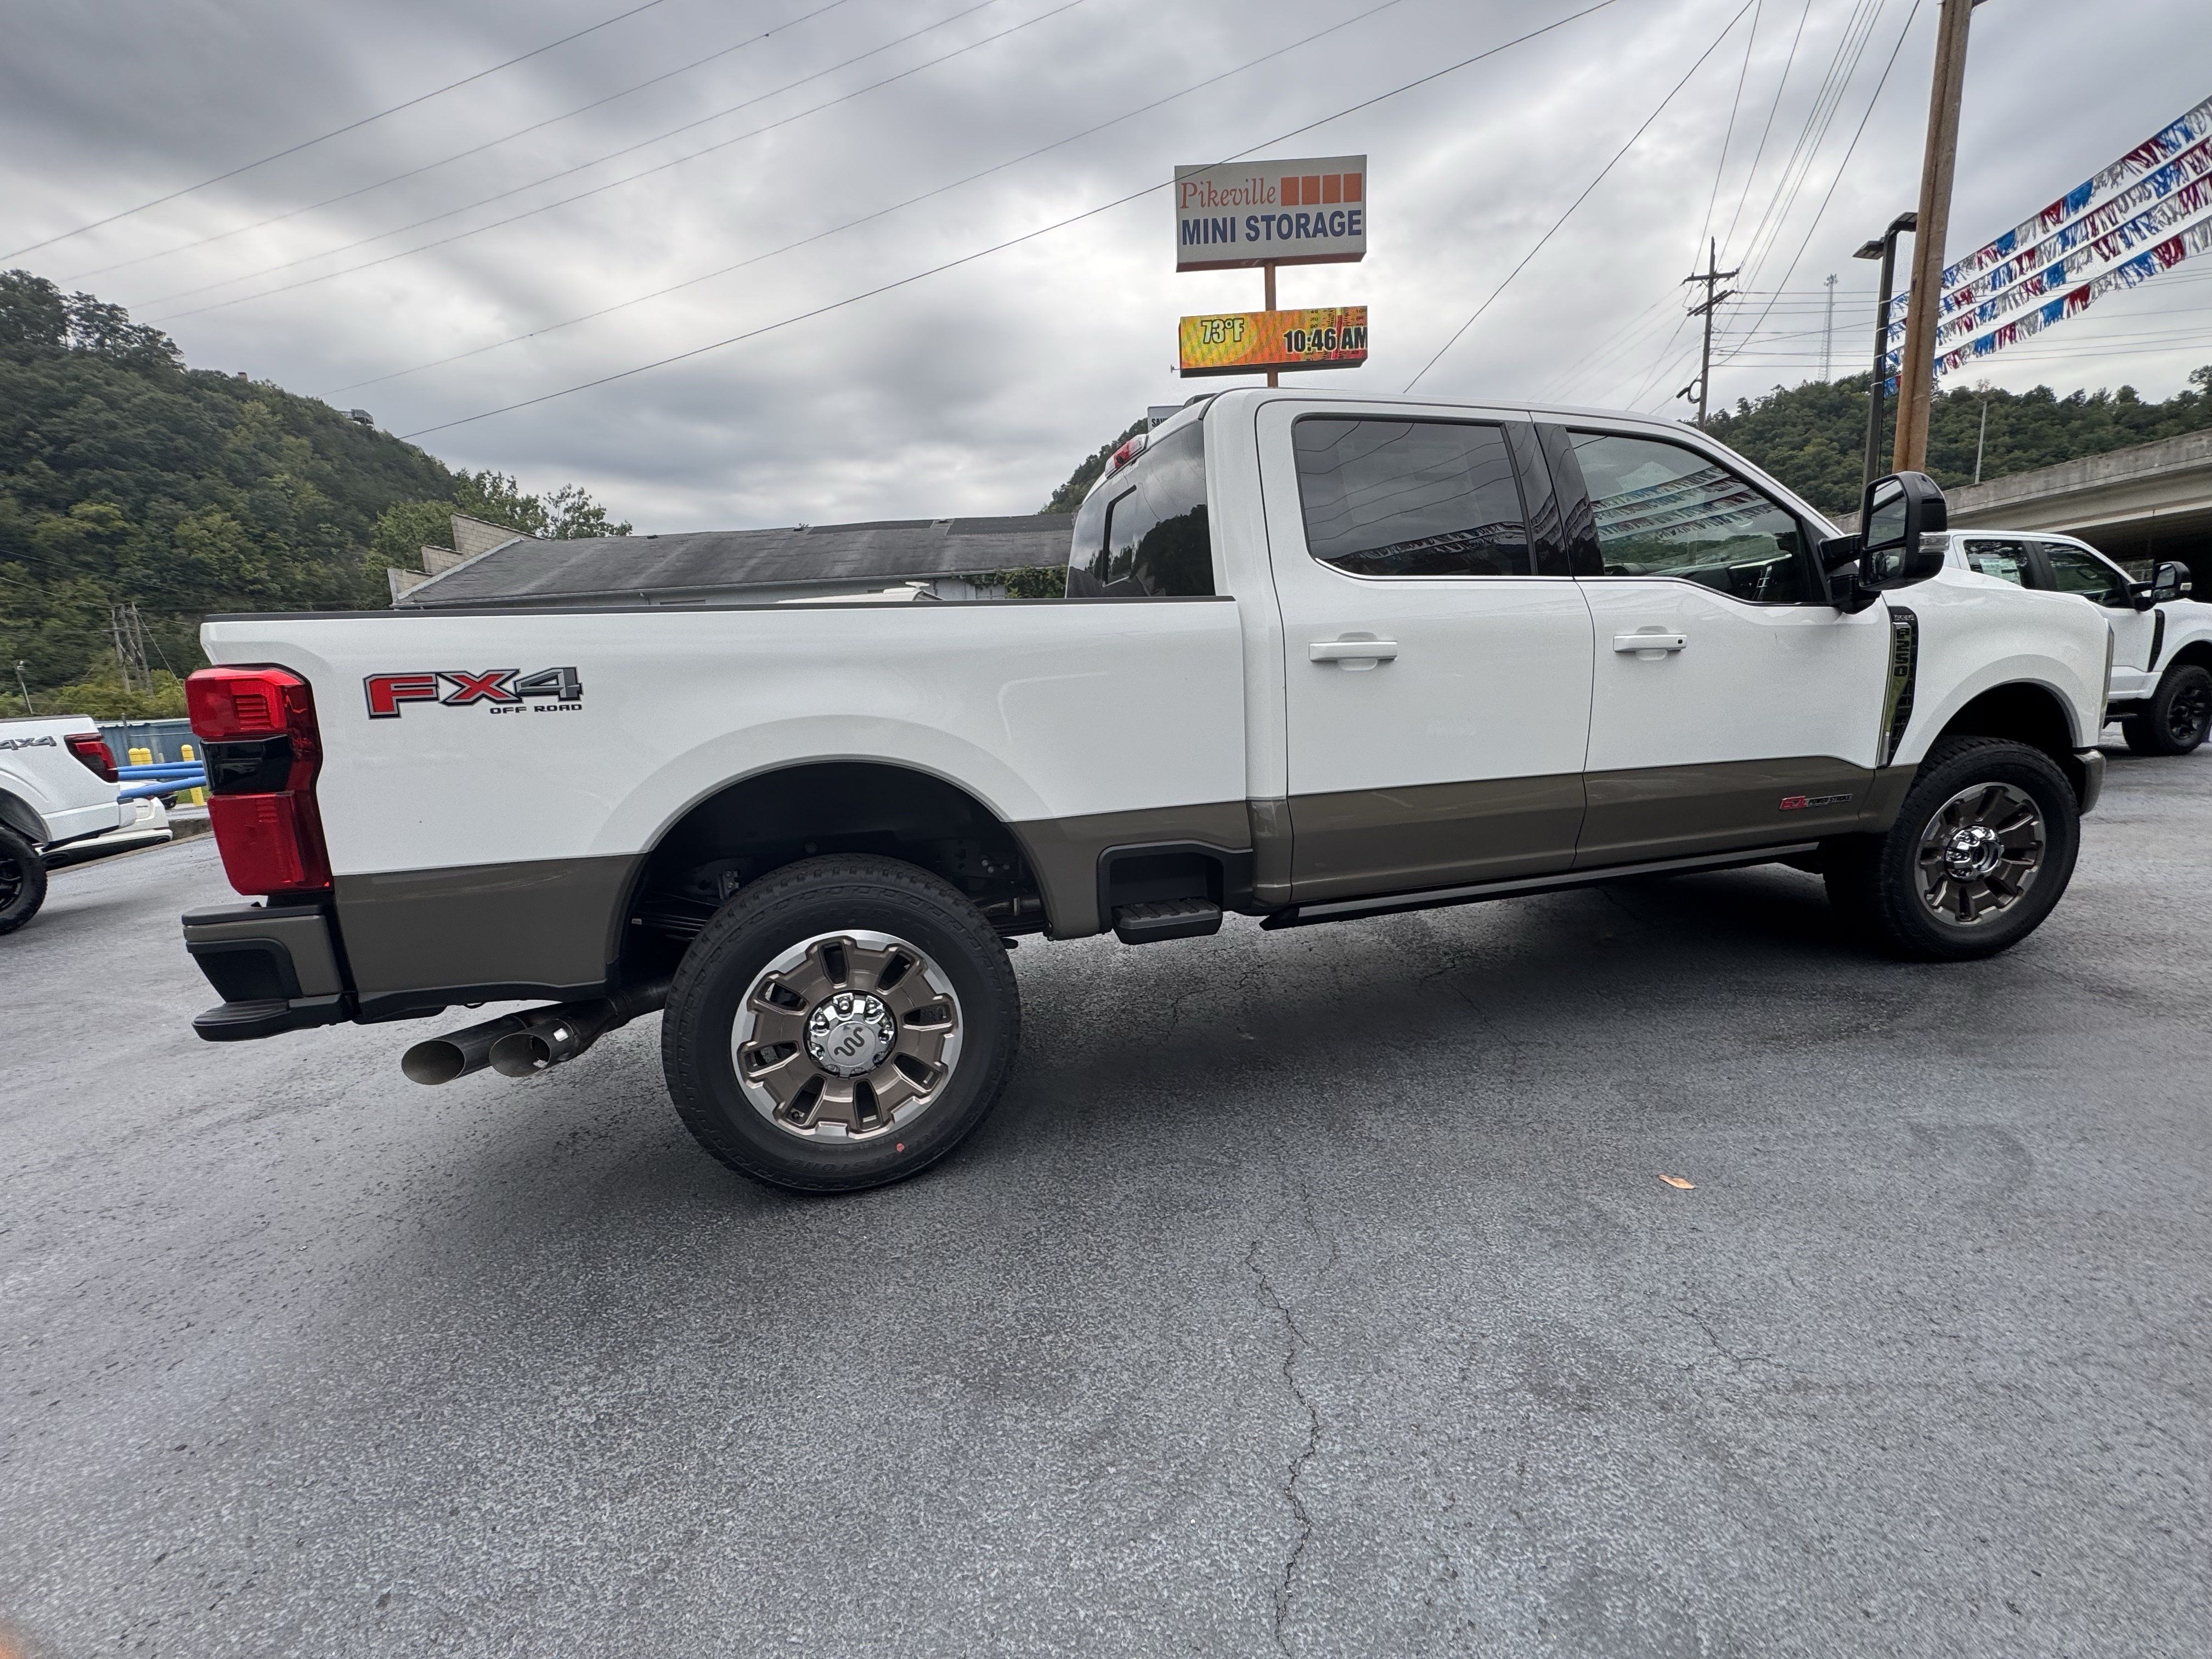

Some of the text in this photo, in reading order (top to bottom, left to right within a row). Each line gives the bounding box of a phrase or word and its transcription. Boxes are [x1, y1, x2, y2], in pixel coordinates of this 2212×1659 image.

[1180, 177, 1276, 209] Pikeville
[1182, 209, 1362, 245] MINI STORAGE
[1283, 326, 1367, 353] 10:46 AM
[362, 665, 584, 720] FX4
[489, 703, 583, 714] OFF ROAD
